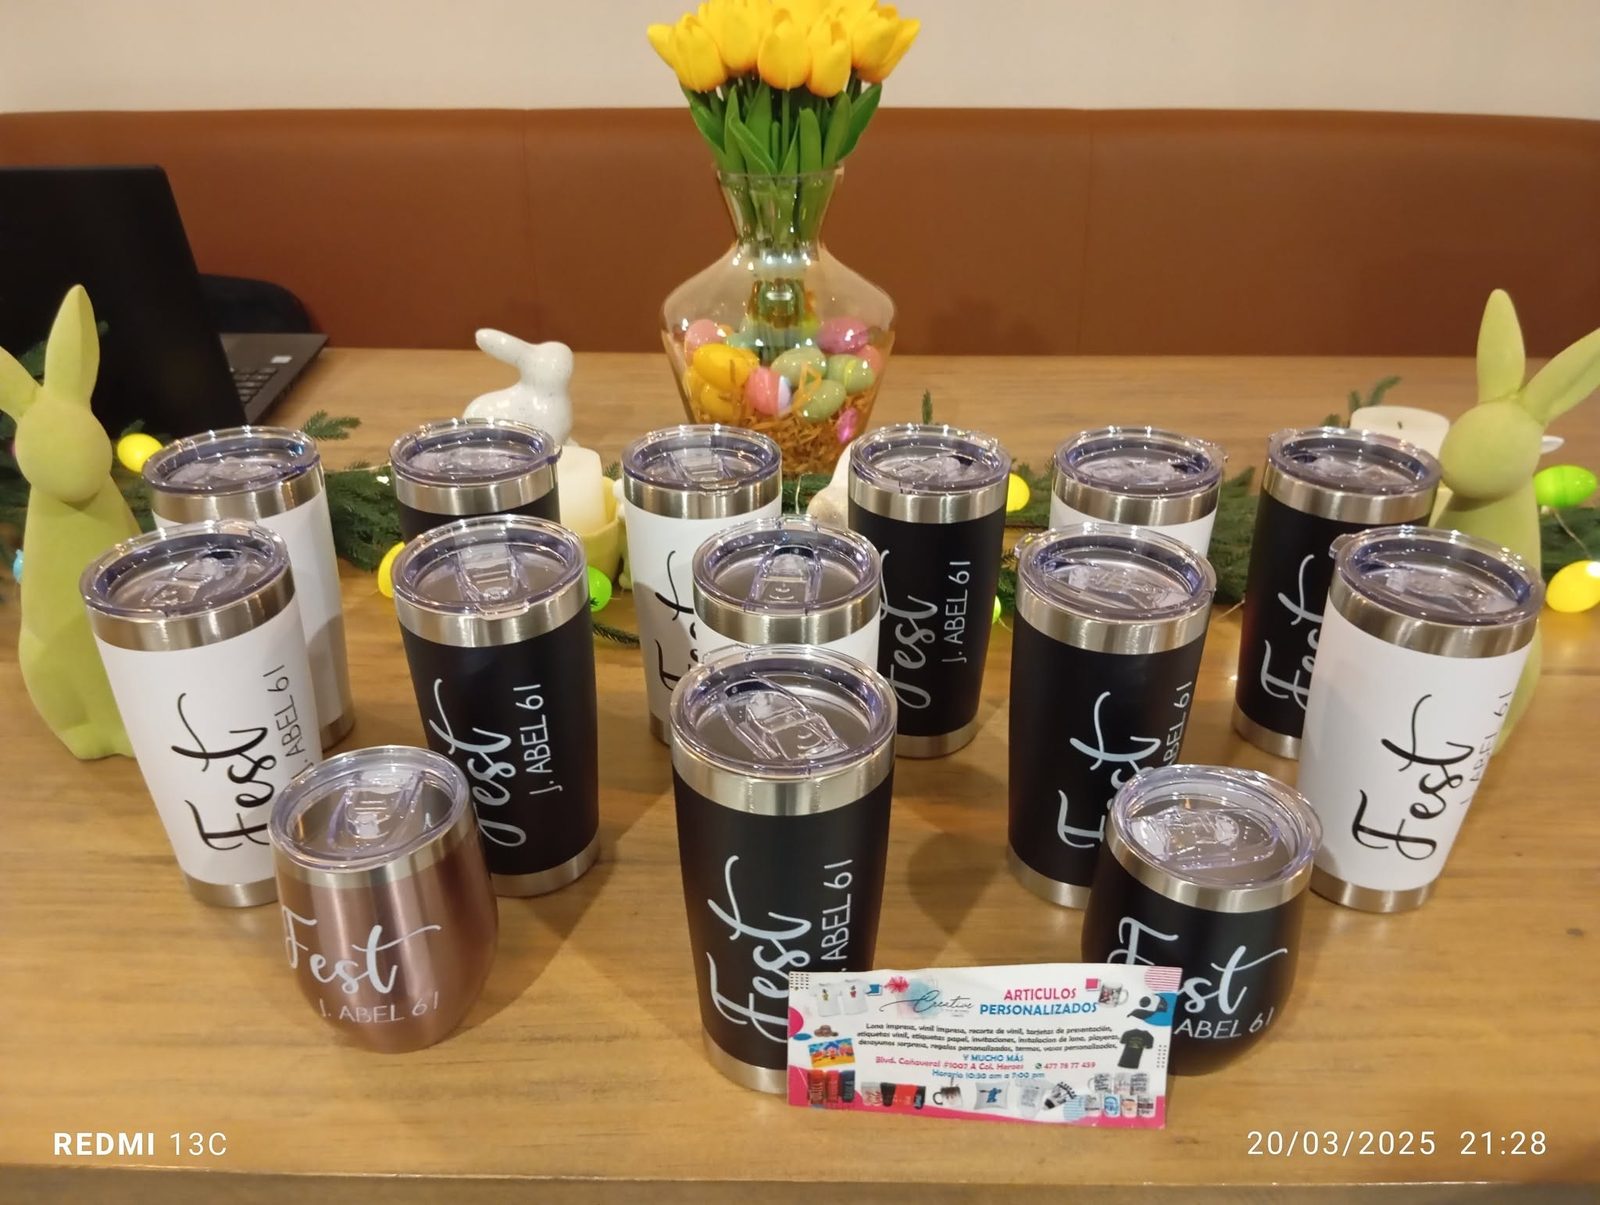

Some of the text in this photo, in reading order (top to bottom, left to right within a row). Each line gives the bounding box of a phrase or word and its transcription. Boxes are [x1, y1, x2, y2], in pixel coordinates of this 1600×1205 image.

[948, 561, 971, 584] 61
[943, 589, 968, 645] ABEL
[262, 664, 290, 692] 61
[513, 684, 544, 710] 61
[274, 694, 306, 757] ABEL
[1163, 681, 1193, 765] BEL 61
[520, 714, 553, 773] ABEL
[1352, 694, 1474, 861] Fest
[821, 859, 853, 960] ABEL 61
[1107, 916, 1288, 1015] Fst
[339, 1004, 405, 1023] ABEL
[412, 991, 439, 1016] 61
[879, 990, 975, 1013] Creative
[1003, 987, 1077, 1001] ARTICULOS
[979, 1002, 1099, 1016] PERSONALIZADOS
[857, 1031, 890, 1039] etiquetas
[912, 1033, 945, 1042] etiquetas
[1174, 1018, 1242, 1039] ABEL
[858, 1039, 895, 1047] desayunos
[930, 1043, 957, 1051] regalos
[971, 1054, 1004, 1062] MUCHO
[932, 1069, 964, 1079] Horario
